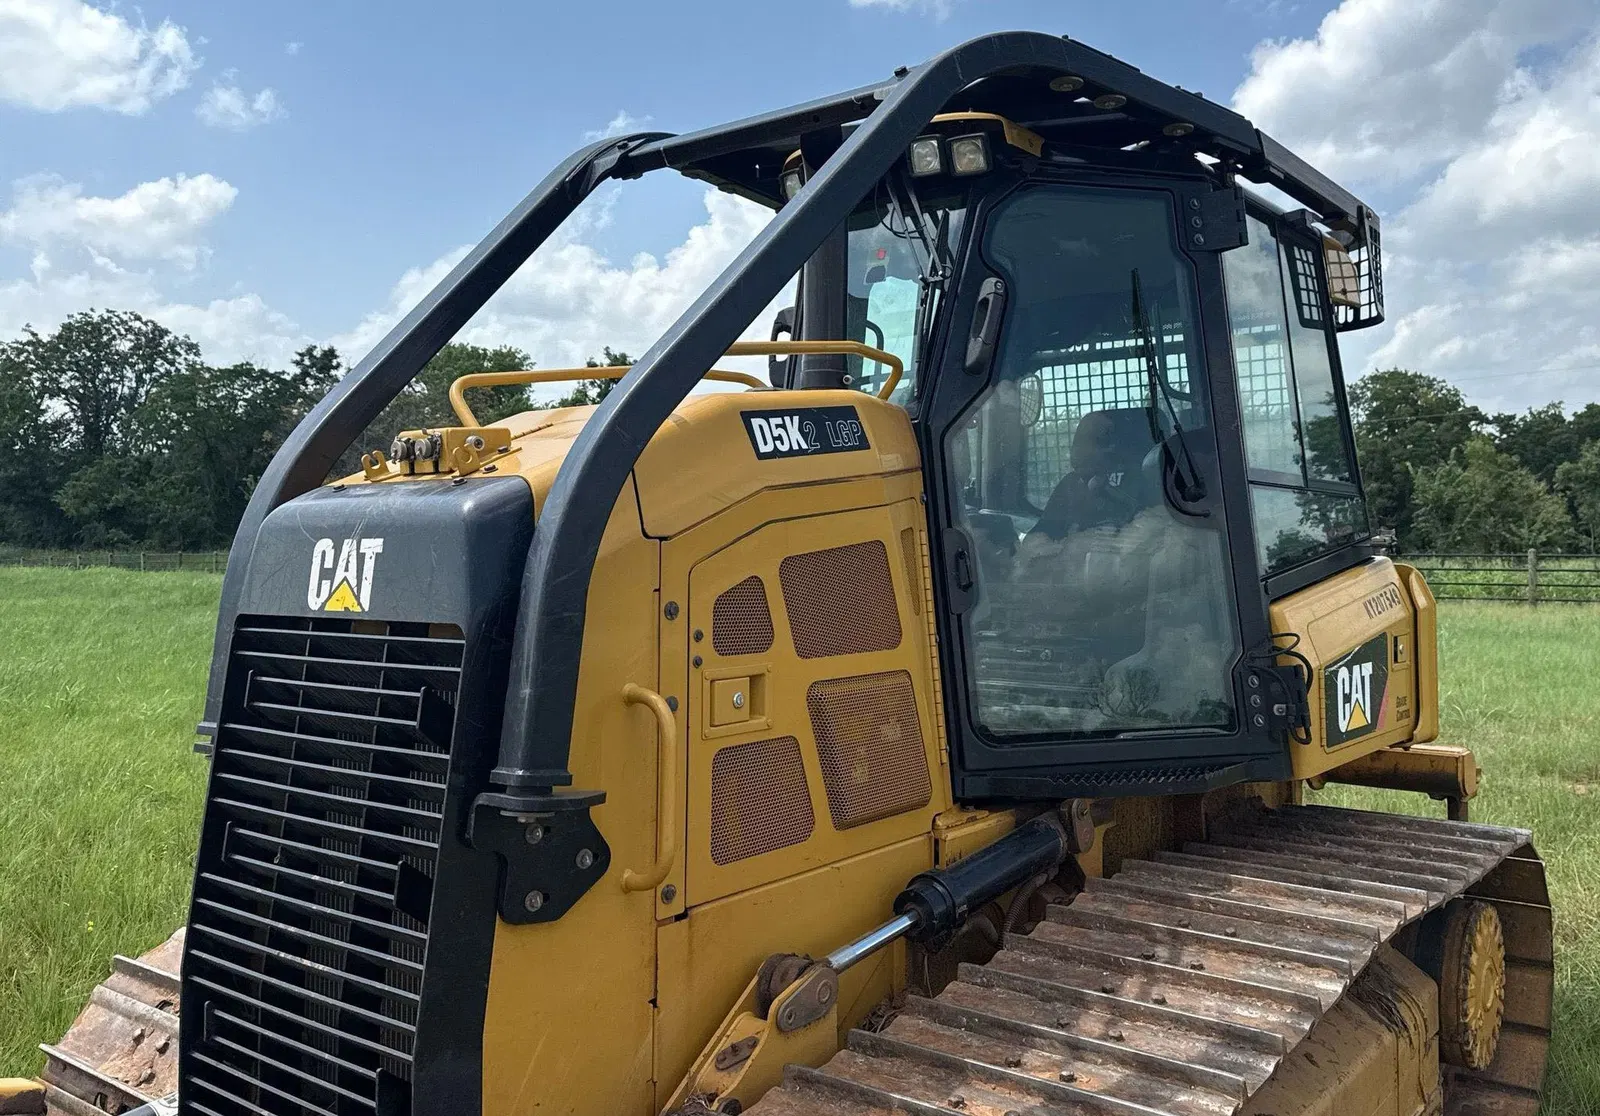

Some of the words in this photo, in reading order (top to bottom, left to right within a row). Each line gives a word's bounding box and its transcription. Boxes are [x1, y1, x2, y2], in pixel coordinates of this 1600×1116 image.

[826, 419, 862, 447] LGP
[307, 537, 384, 612] CAT
[1337, 661, 1373, 733] CAT
